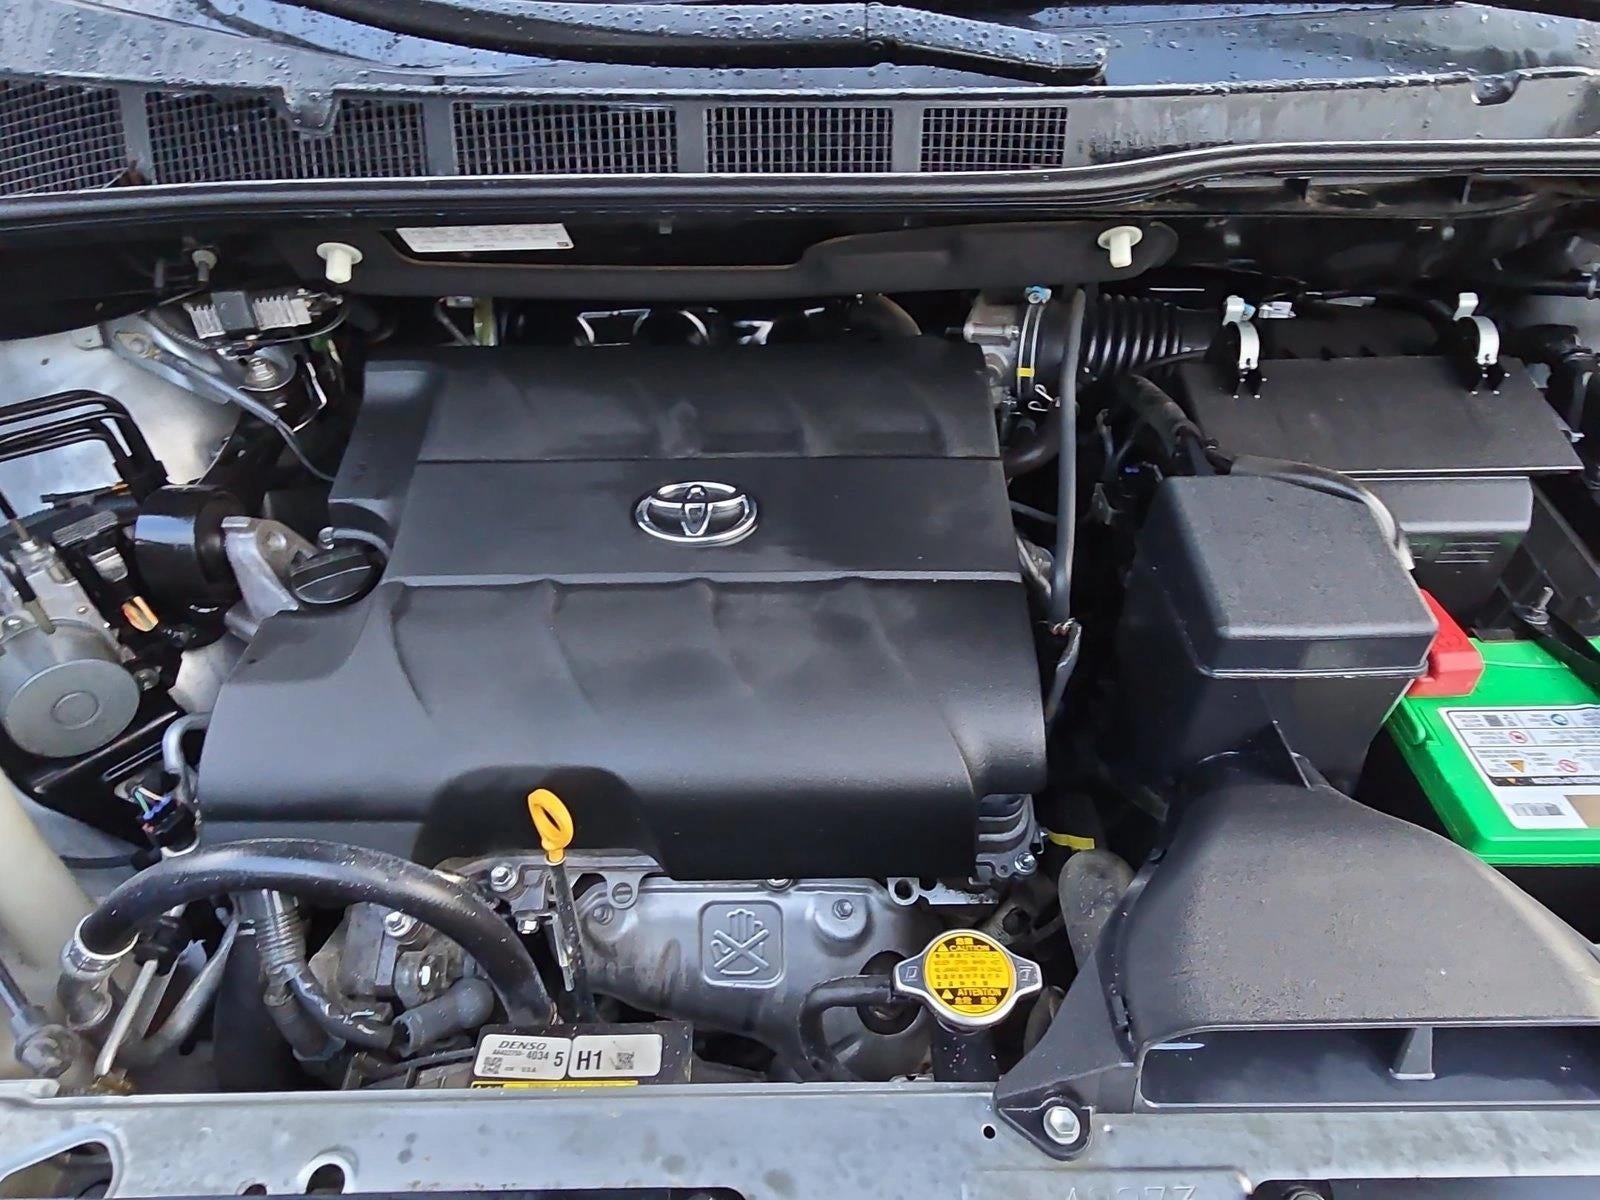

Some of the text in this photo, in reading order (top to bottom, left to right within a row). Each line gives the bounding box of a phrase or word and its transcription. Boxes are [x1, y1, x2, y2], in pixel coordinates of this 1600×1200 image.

[957, 988, 1002, 996] ATTENTION
[498, 1040, 547, 1051] DENSO
[526, 1050, 550, 1060] 4034
[553, 1051, 565, 1067] 5
[576, 1050, 603, 1071] H1
